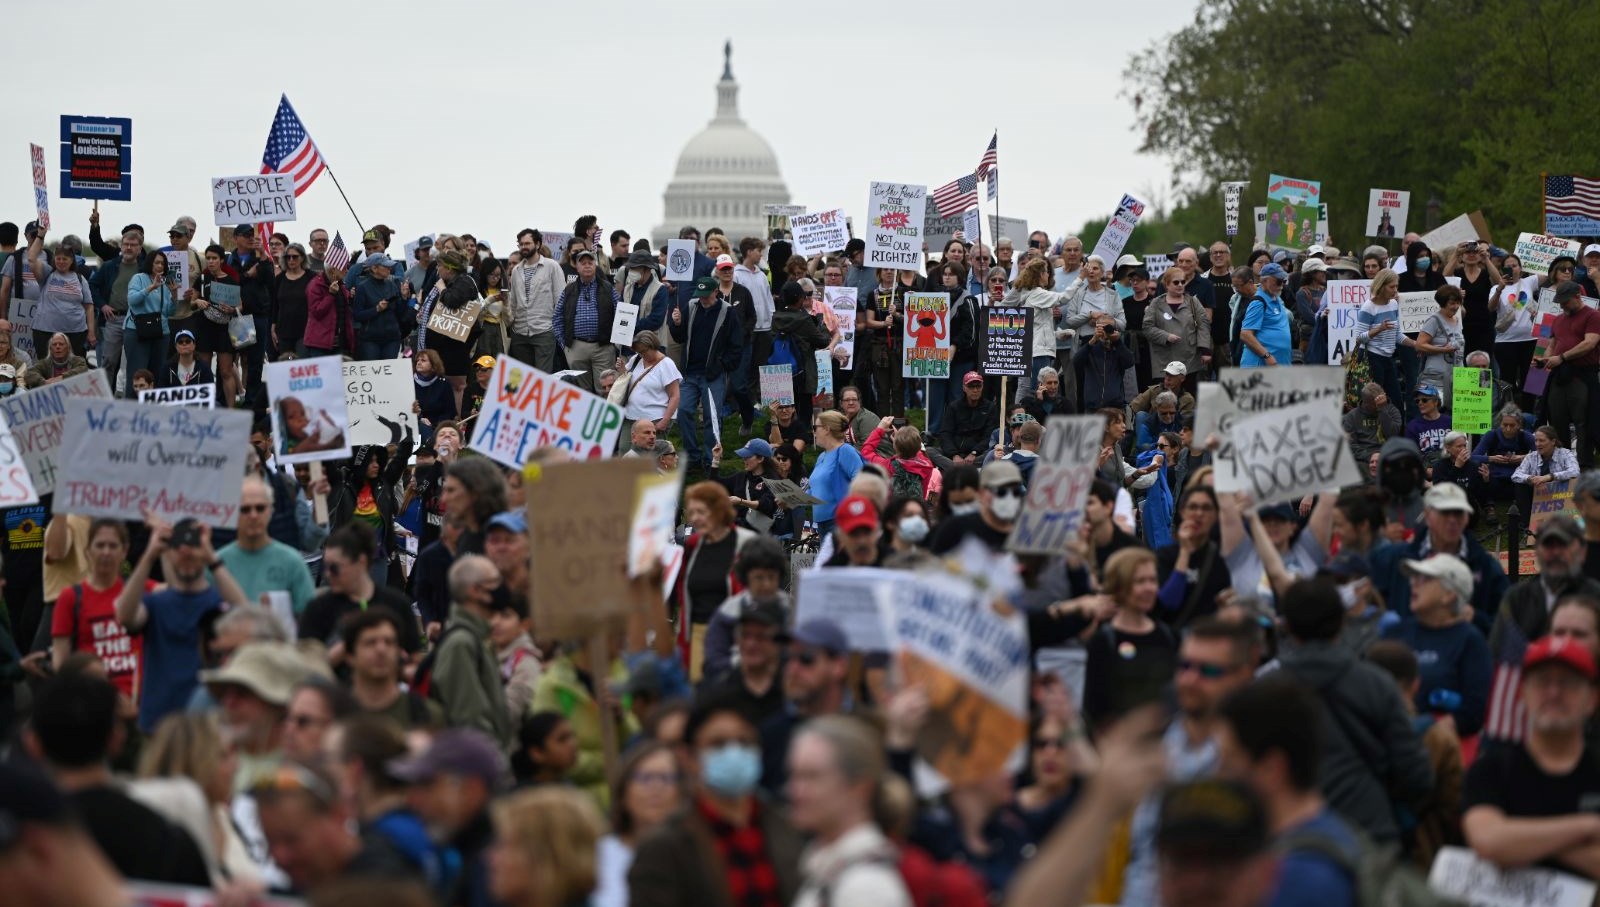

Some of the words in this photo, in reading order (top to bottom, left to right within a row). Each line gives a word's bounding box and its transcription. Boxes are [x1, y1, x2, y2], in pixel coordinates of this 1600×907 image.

[77, 124, 105, 133] Disappear
[78, 137, 90, 145] New
[73, 145, 120, 156] Louisiana.
[227, 177, 288, 196] PEOPLE
[1382, 191, 1399, 199] DEPORT
[225, 195, 294, 217] POWER!
[791, 213, 820, 228] HANDS
[820, 209, 838, 224] OFF
[799, 228, 844, 245] CONSTITUTION
[876, 234, 893, 246] NOT
[893, 242, 911, 251] OUR
[871, 250, 918, 264] RIGHTS!!
[442, 305, 469, 319] NOT
[429, 313, 471, 337] PROFIT
[987, 308, 1026, 337] NO!
[906, 347, 949, 361] EDUCATION
[289, 364, 319, 379] SAVE
[342, 365, 368, 376] ERE
[371, 364, 393, 378] WE
[761, 364, 792, 375] TRANS
[910, 359, 949, 377] POWER
[981, 361, 1004, 369] Fascist
[1004, 362, 1028, 370] America
[288, 378, 323, 392] USAID
[347, 381, 373, 394] GO
[143, 386, 210, 402] HANDS
[497, 359, 583, 432] WAKE
[581, 398, 621, 442] UP
[85, 405, 121, 433] We
[130, 408, 160, 436] the
[168, 412, 225, 448] People
[1038, 419, 1101, 465] OMG
[1249, 414, 1317, 459] AXE
[107, 441, 140, 466] will
[146, 442, 228, 471] Overcome
[1027, 464, 1093, 512] GOP
[149, 490, 238, 521] Autocracy
[1531, 499, 1566, 515] FACTS
[534, 516, 634, 548] HAND
[1012, 510, 1083, 548] WTF
[94, 636, 132, 658] THE
